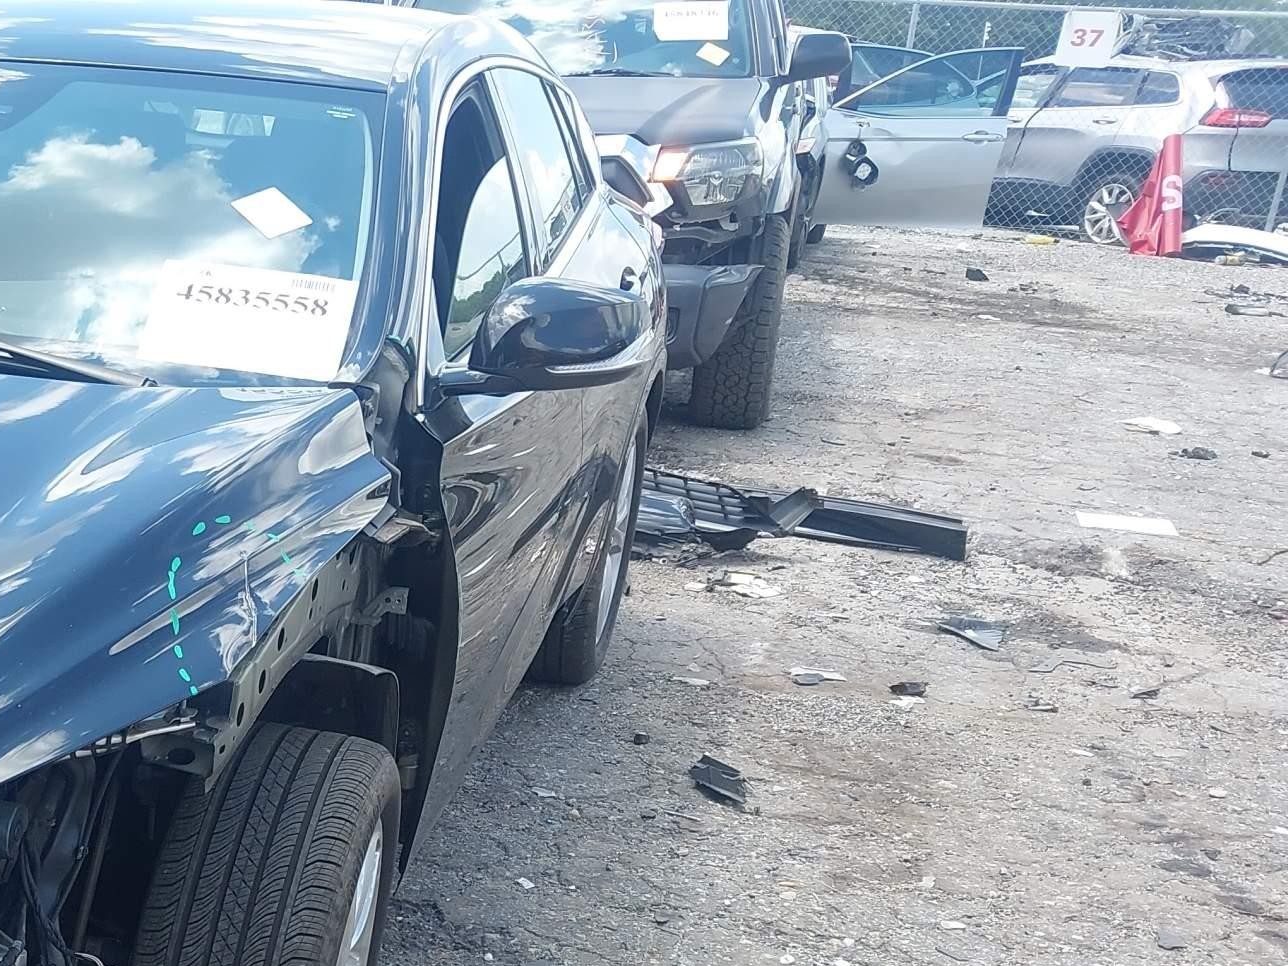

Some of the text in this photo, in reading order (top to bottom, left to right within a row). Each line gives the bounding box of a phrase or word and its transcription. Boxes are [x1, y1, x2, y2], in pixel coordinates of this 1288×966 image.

[1070, 28, 1105, 47] 37
[1161, 174, 1183, 211] S
[176, 283, 328, 316] 45835558
